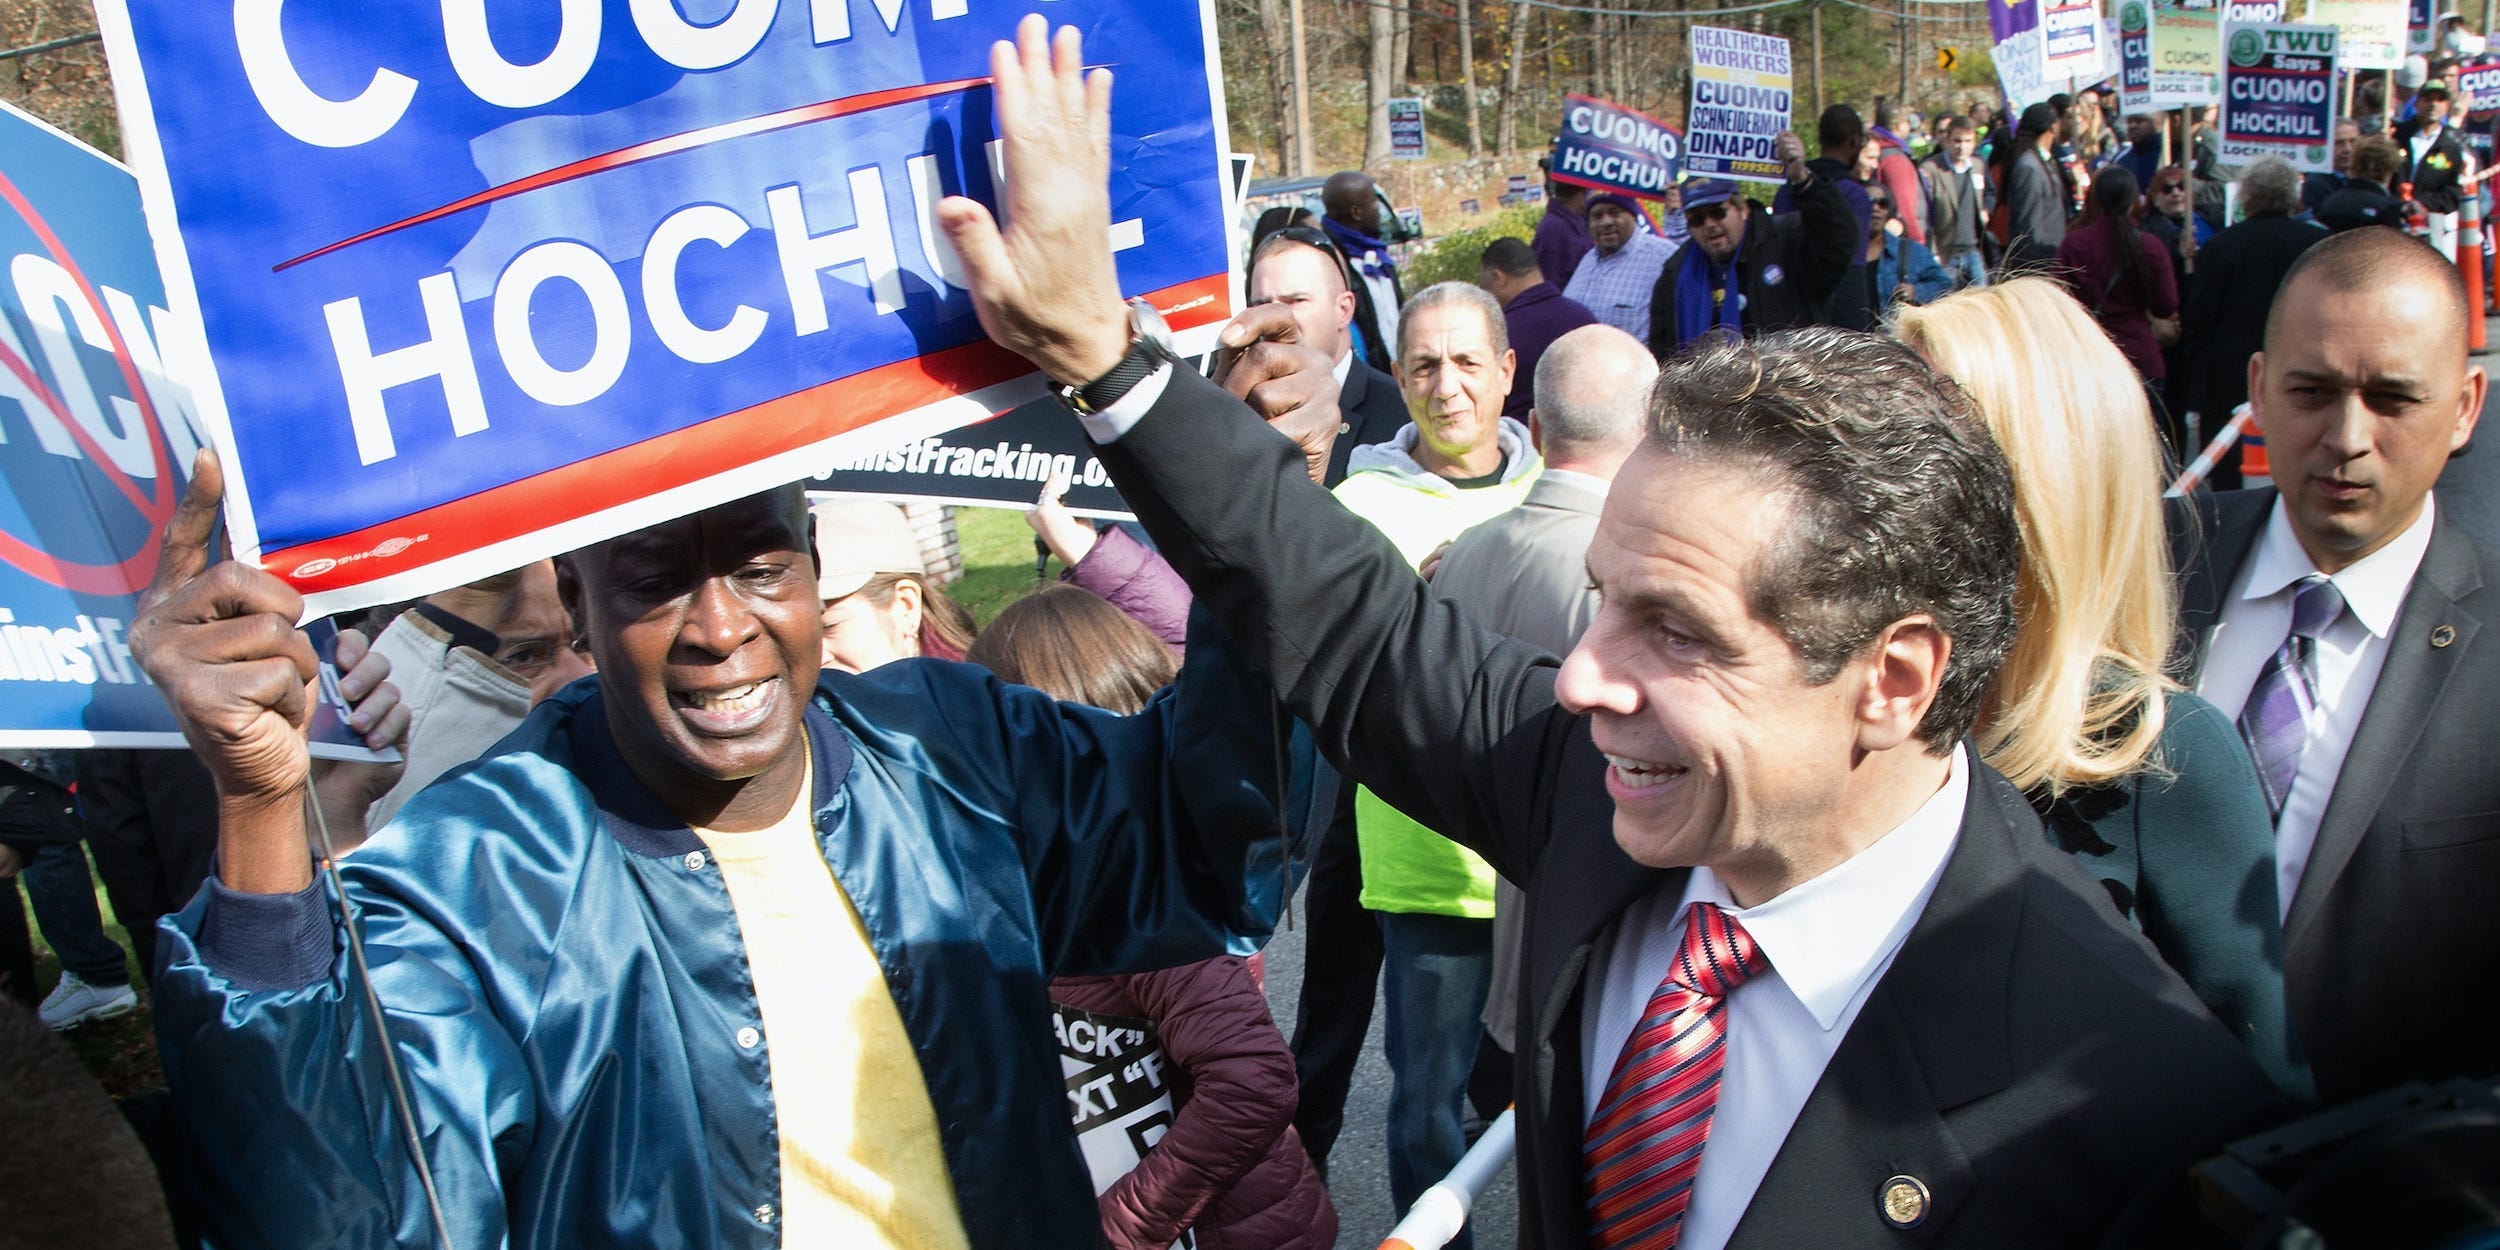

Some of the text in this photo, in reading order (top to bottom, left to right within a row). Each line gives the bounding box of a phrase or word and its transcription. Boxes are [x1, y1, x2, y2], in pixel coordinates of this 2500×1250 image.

[1694, 29, 1787, 56] HEALTHCARE
[2265, 30, 2334, 52] TWU
[1696, 47, 1788, 75] WORKERS
[2165, 50, 2211, 65] CUOMO
[2273, 54, 2321, 72] Says
[1696, 80, 1788, 112] CUOMO
[2231, 76, 2326, 103] CUOMO
[1570, 106, 1678, 160] CUOMO
[1692, 106, 1788, 136] SCHNEIDERMAN
[2231, 112, 2322, 136] HOCHUL
[1562, 147, 1669, 190] HOCHUL
[322, 139, 1144, 467] HOCHU
